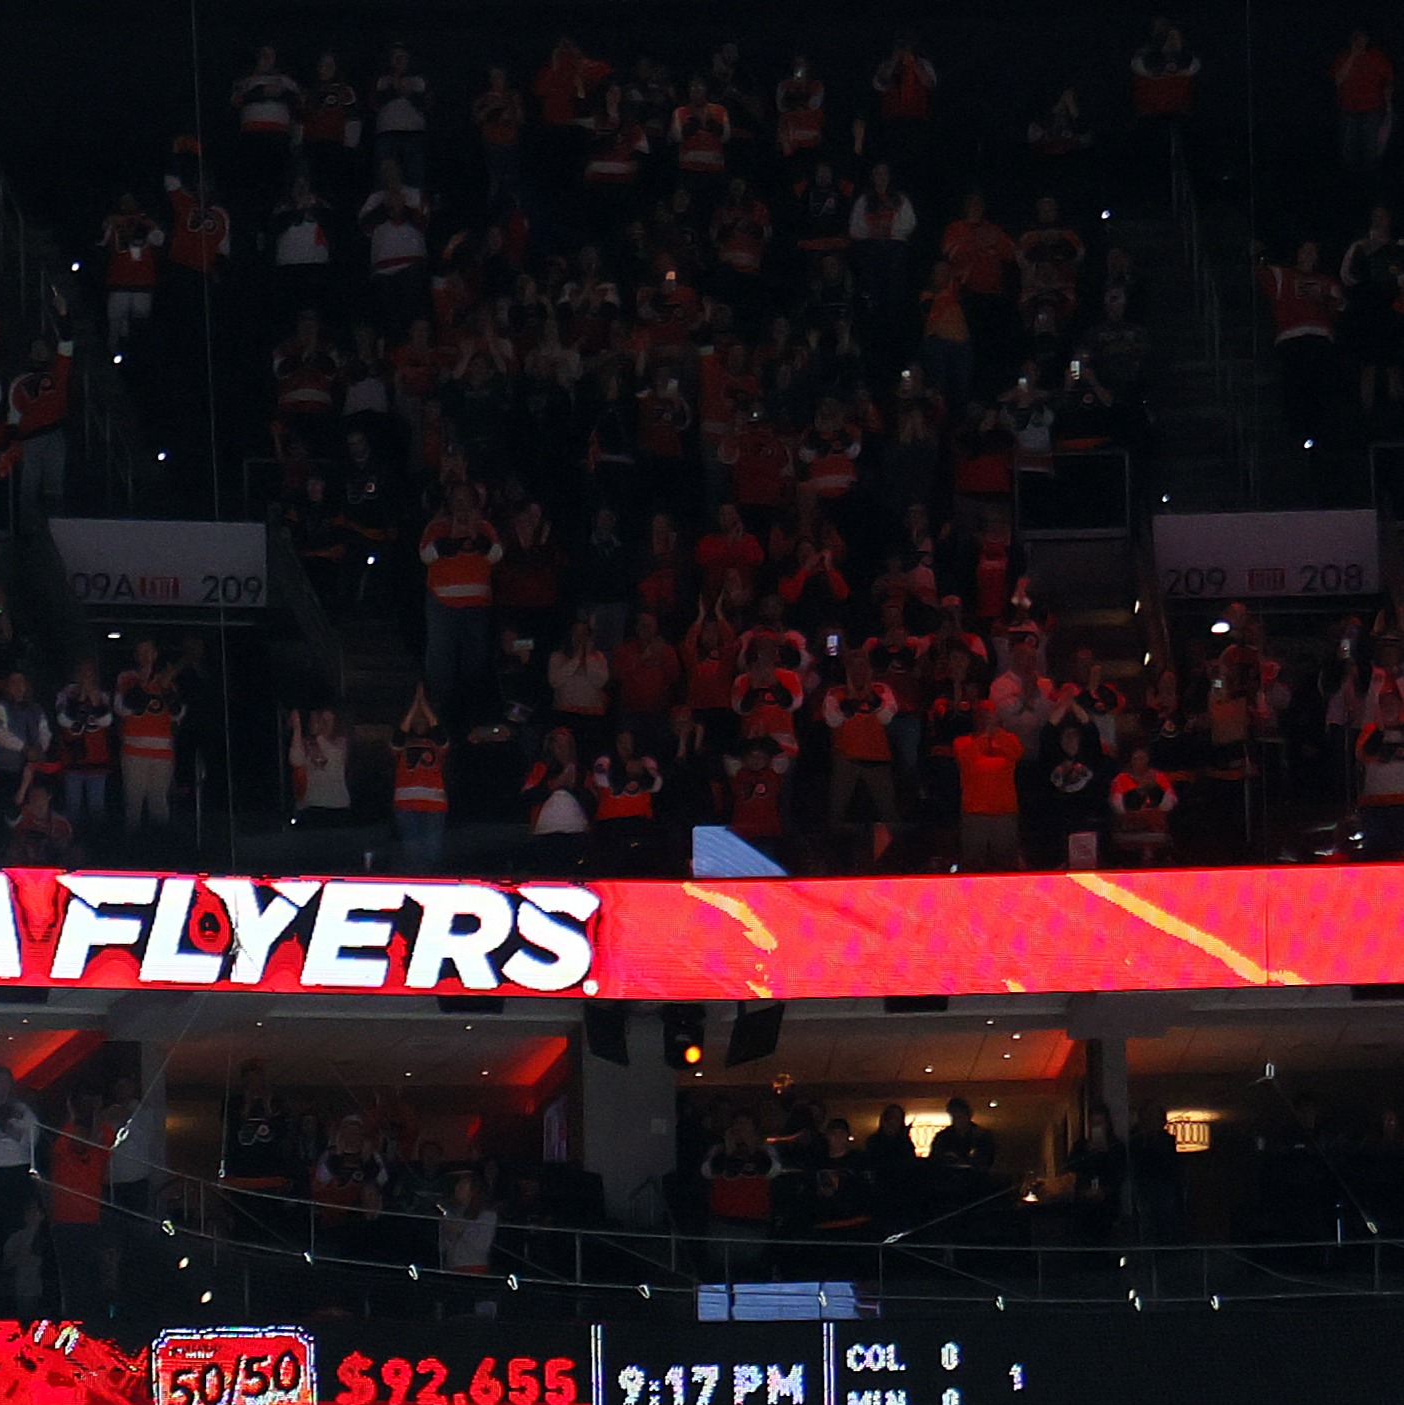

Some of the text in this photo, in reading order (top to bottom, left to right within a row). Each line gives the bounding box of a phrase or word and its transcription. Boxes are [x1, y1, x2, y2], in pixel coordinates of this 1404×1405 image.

[71, 572, 136, 600] 09A
[201, 574, 263, 604] 209
[1165, 566, 1227, 596] 209
[1299, 563, 1364, 593] 208
[48, 872, 597, 992] FLYERS
[941, 1342, 958, 1371] 0
[733, 1363, 804, 1405] PM
[1010, 1364, 1025, 1391] 1
